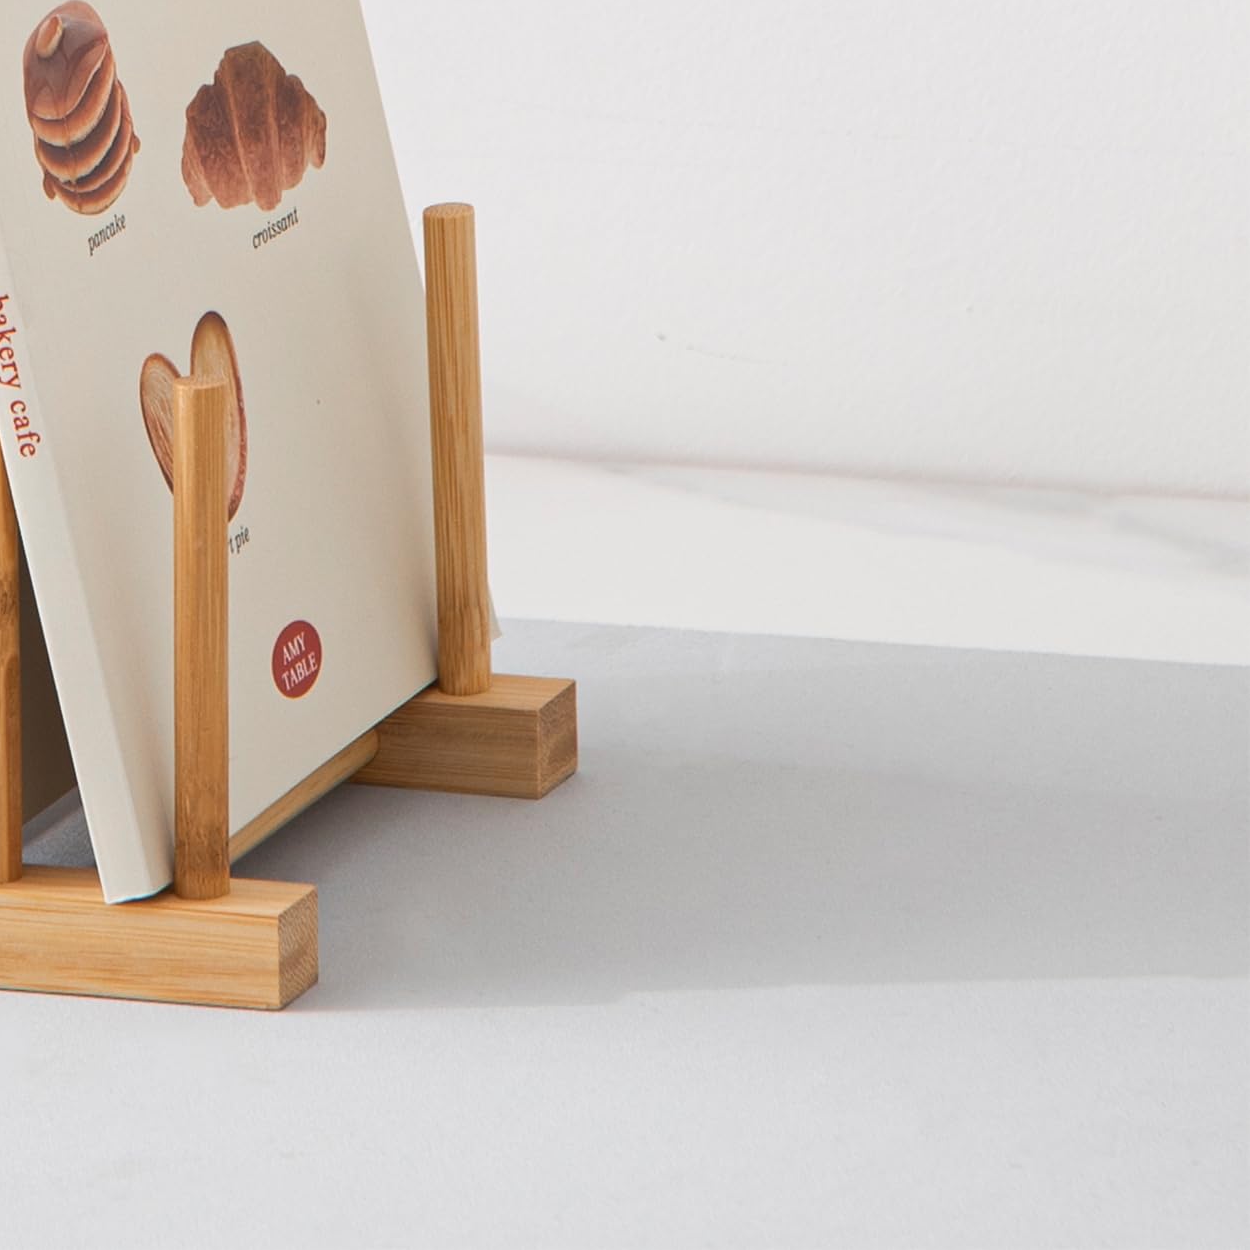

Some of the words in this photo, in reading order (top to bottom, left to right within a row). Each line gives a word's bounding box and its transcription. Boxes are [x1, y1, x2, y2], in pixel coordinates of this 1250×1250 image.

[87, 212, 127, 256] pancake
[252, 207, 299, 250] croissant
[10, 398, 41, 458] cafe
[235, 526, 250, 554] pie
[282, 631, 306, 666] AMY
[282, 653, 318, 691] TABLE
